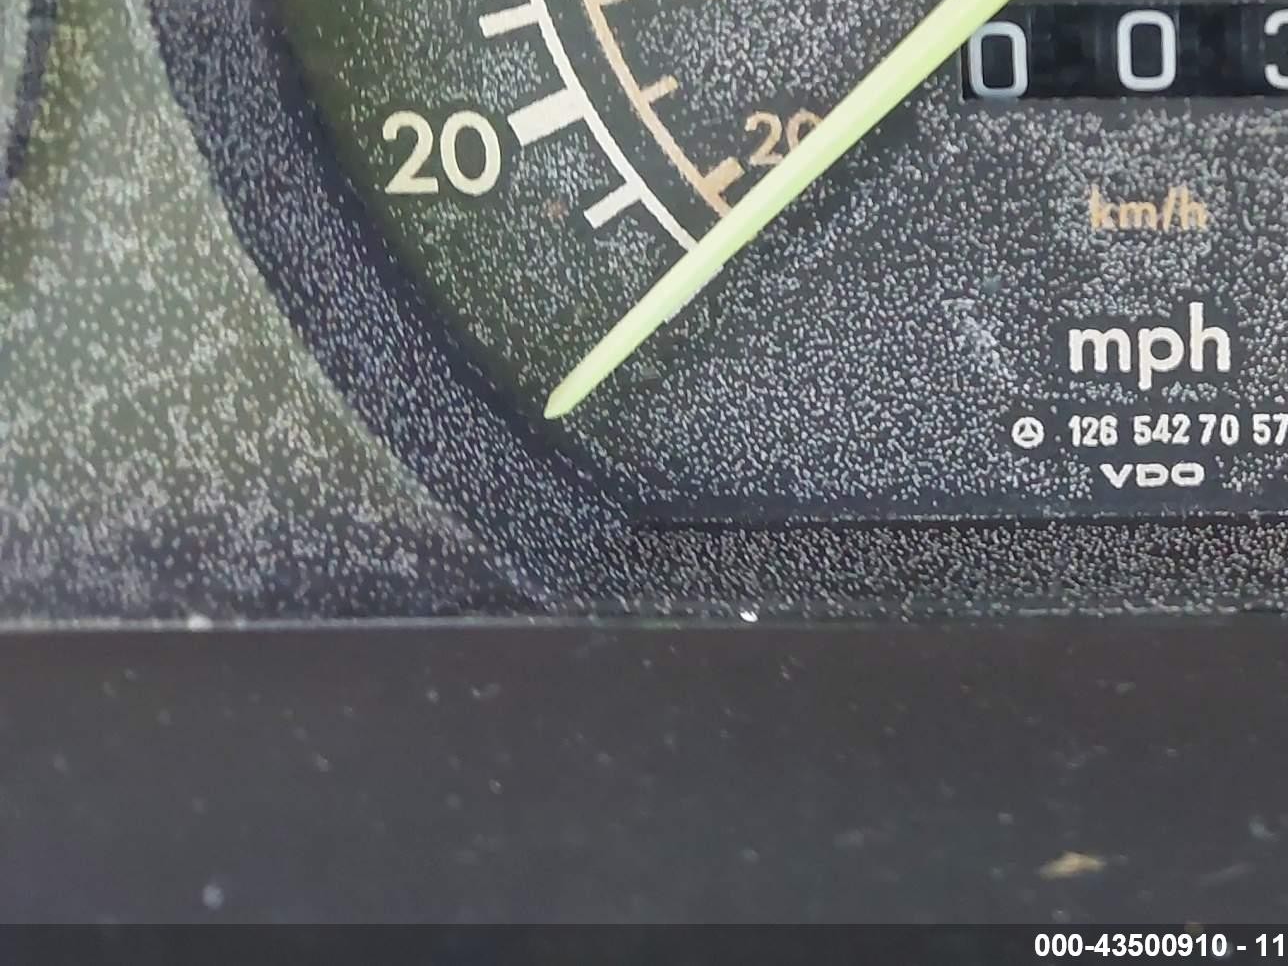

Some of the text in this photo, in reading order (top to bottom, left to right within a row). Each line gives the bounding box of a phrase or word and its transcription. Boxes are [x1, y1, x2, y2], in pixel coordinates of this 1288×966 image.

[381, 111, 501, 197] 20
[1089, 186, 1208, 232] km/h
[1068, 302, 1231, 390] mph
[1068, 414, 1119, 447] 126
[1133, 413, 1191, 446] 542
[1198, 413, 1240, 446] 70
[1099, 462, 1205, 489] VDO
